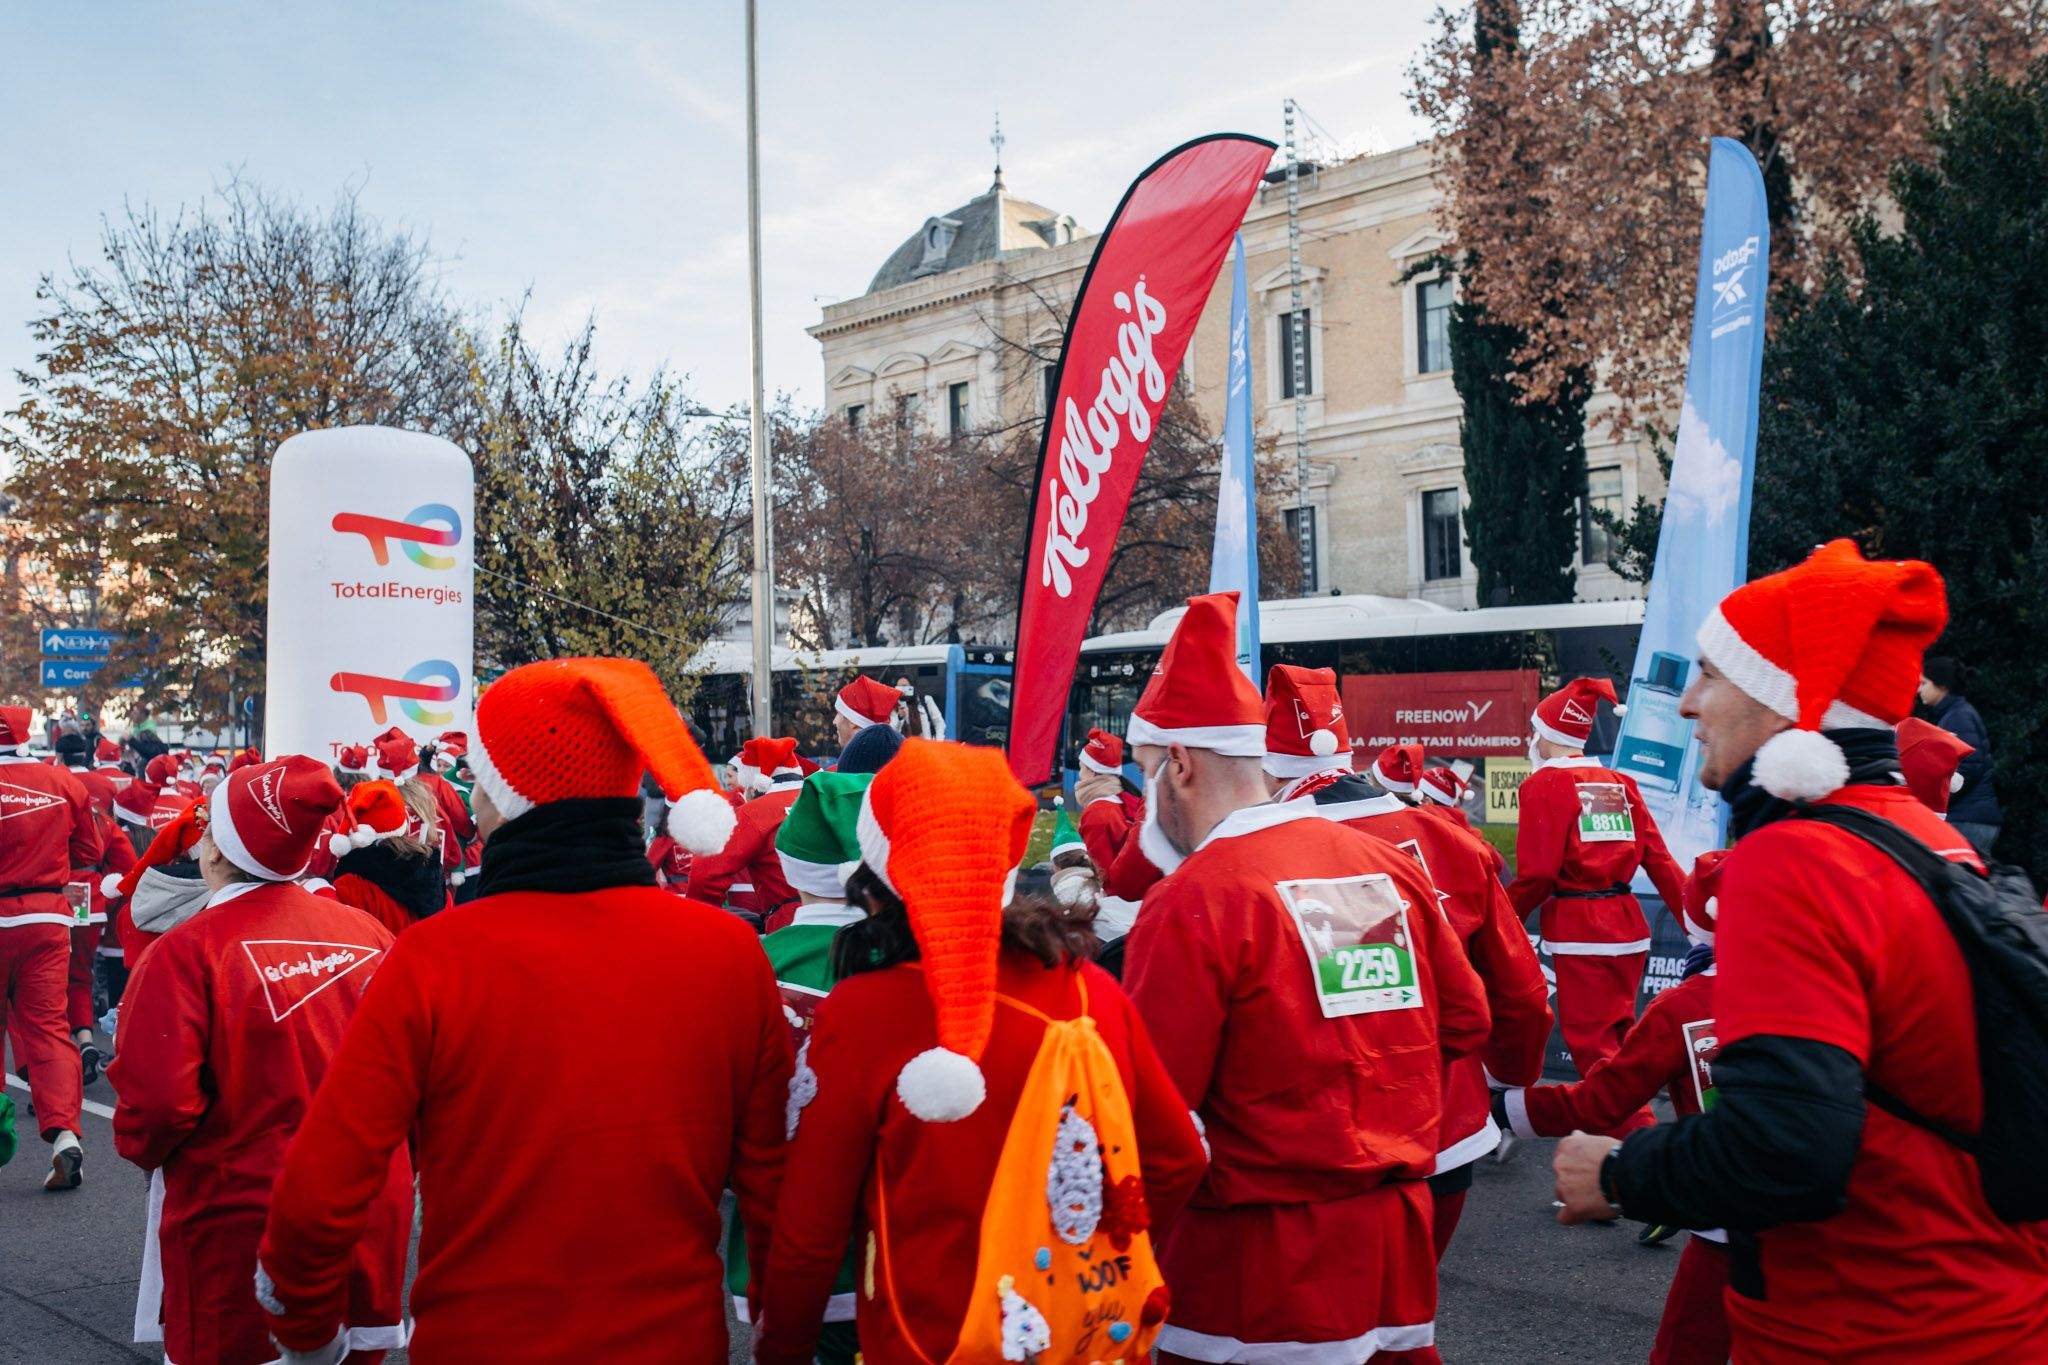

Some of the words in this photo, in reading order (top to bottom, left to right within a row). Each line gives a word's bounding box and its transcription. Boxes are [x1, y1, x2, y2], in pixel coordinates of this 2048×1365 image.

[1043, 273, 1167, 598] Kellogg's
[332, 582, 462, 604] TotalEnergies
[47, 668, 56, 679] A
[1396, 709, 1469, 724] FREENOW
[1349, 737, 1364, 746] LA
[1369, 737, 1395, 746] APP
[1400, 737, 1418, 745] DE
[1422, 737, 1453, 746] TAXI
[1457, 734, 1521, 747] NÚMERO
[1492, 791, 1506, 809] LA
[1510, 791, 1518, 809] A
[1591, 815, 1625, 831] 8811
[1336, 947, 1402, 989] 2259
[1648, 956, 1687, 977] FRAG
[1560, 1052, 1573, 1061] TA
